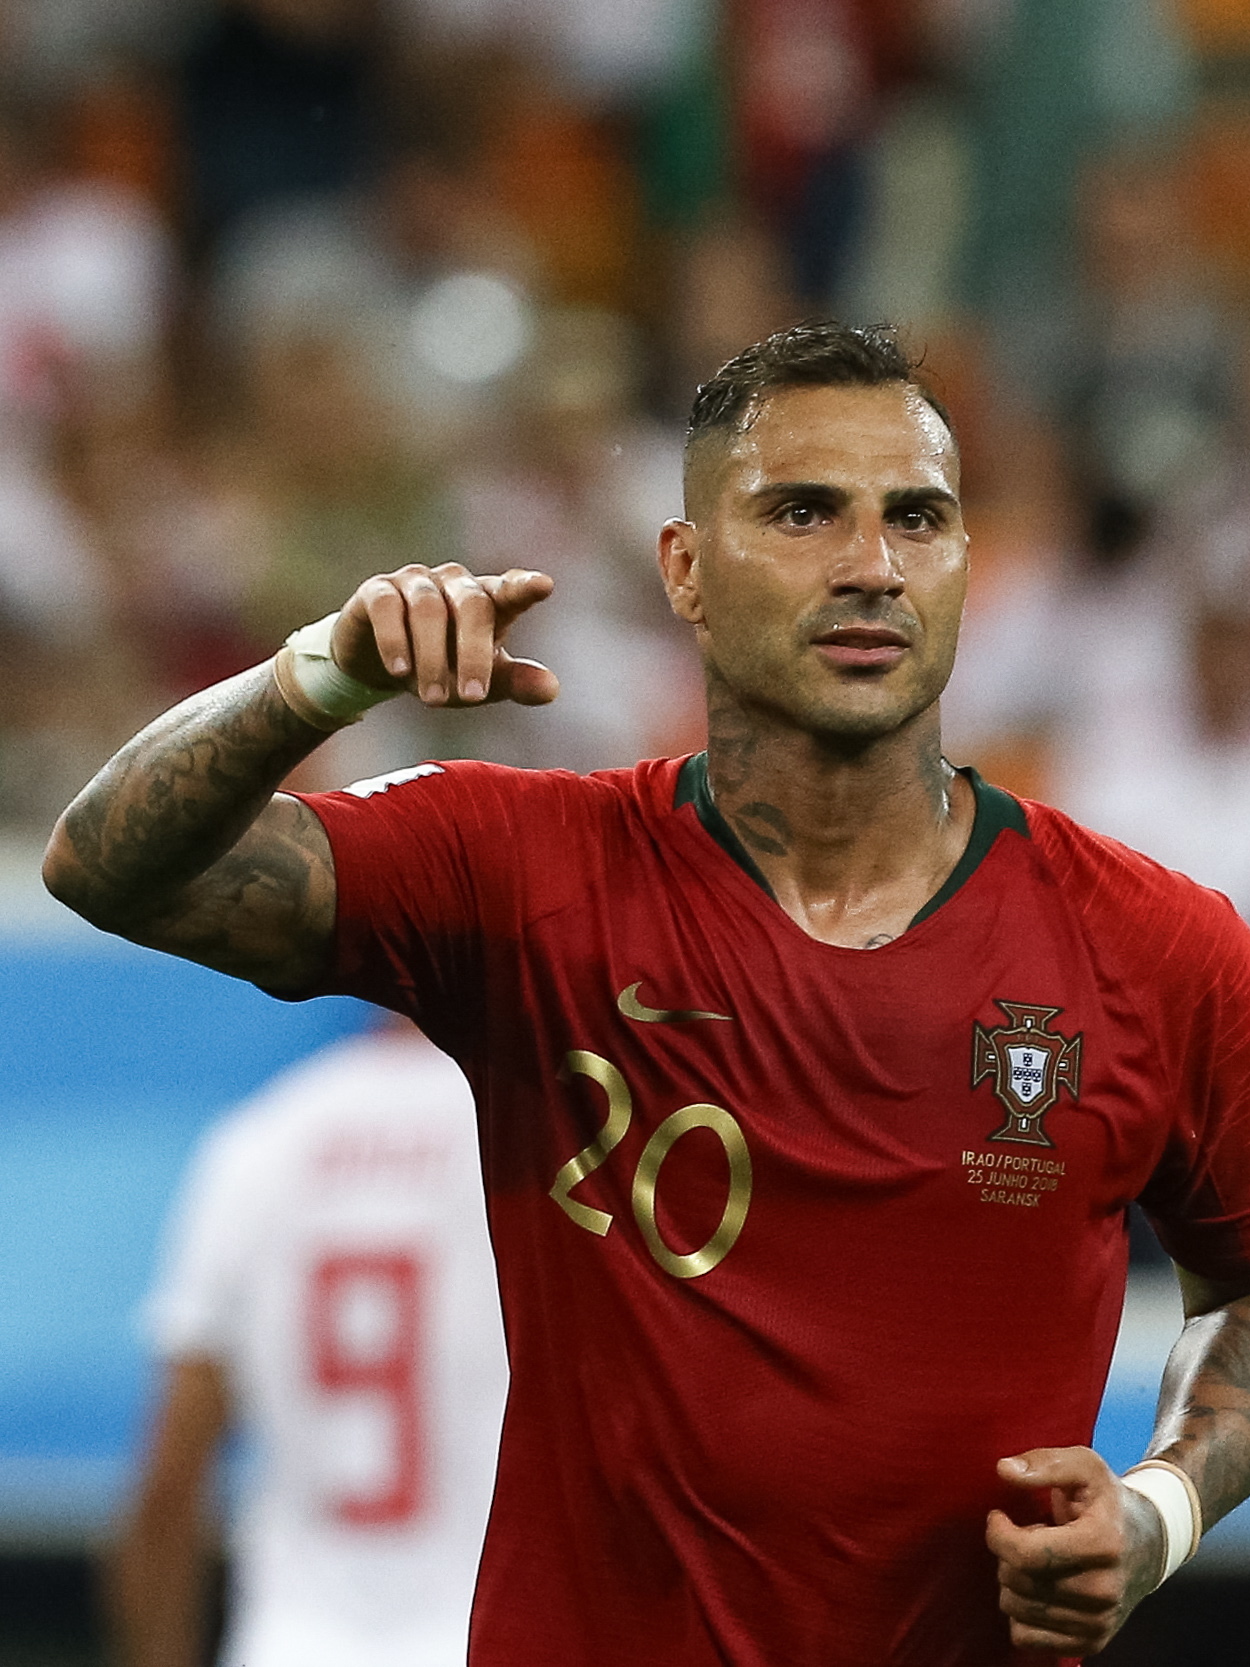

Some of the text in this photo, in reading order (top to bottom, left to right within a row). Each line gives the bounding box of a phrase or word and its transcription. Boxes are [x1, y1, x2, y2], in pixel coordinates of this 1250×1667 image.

[549, 1050, 753, 1279] 20
[967, 1169, 1058, 1191] 25 JUNHO 2018
[980, 1188, 1041, 1207] SARANSK
[306, 1244, 428, 1528] 9
